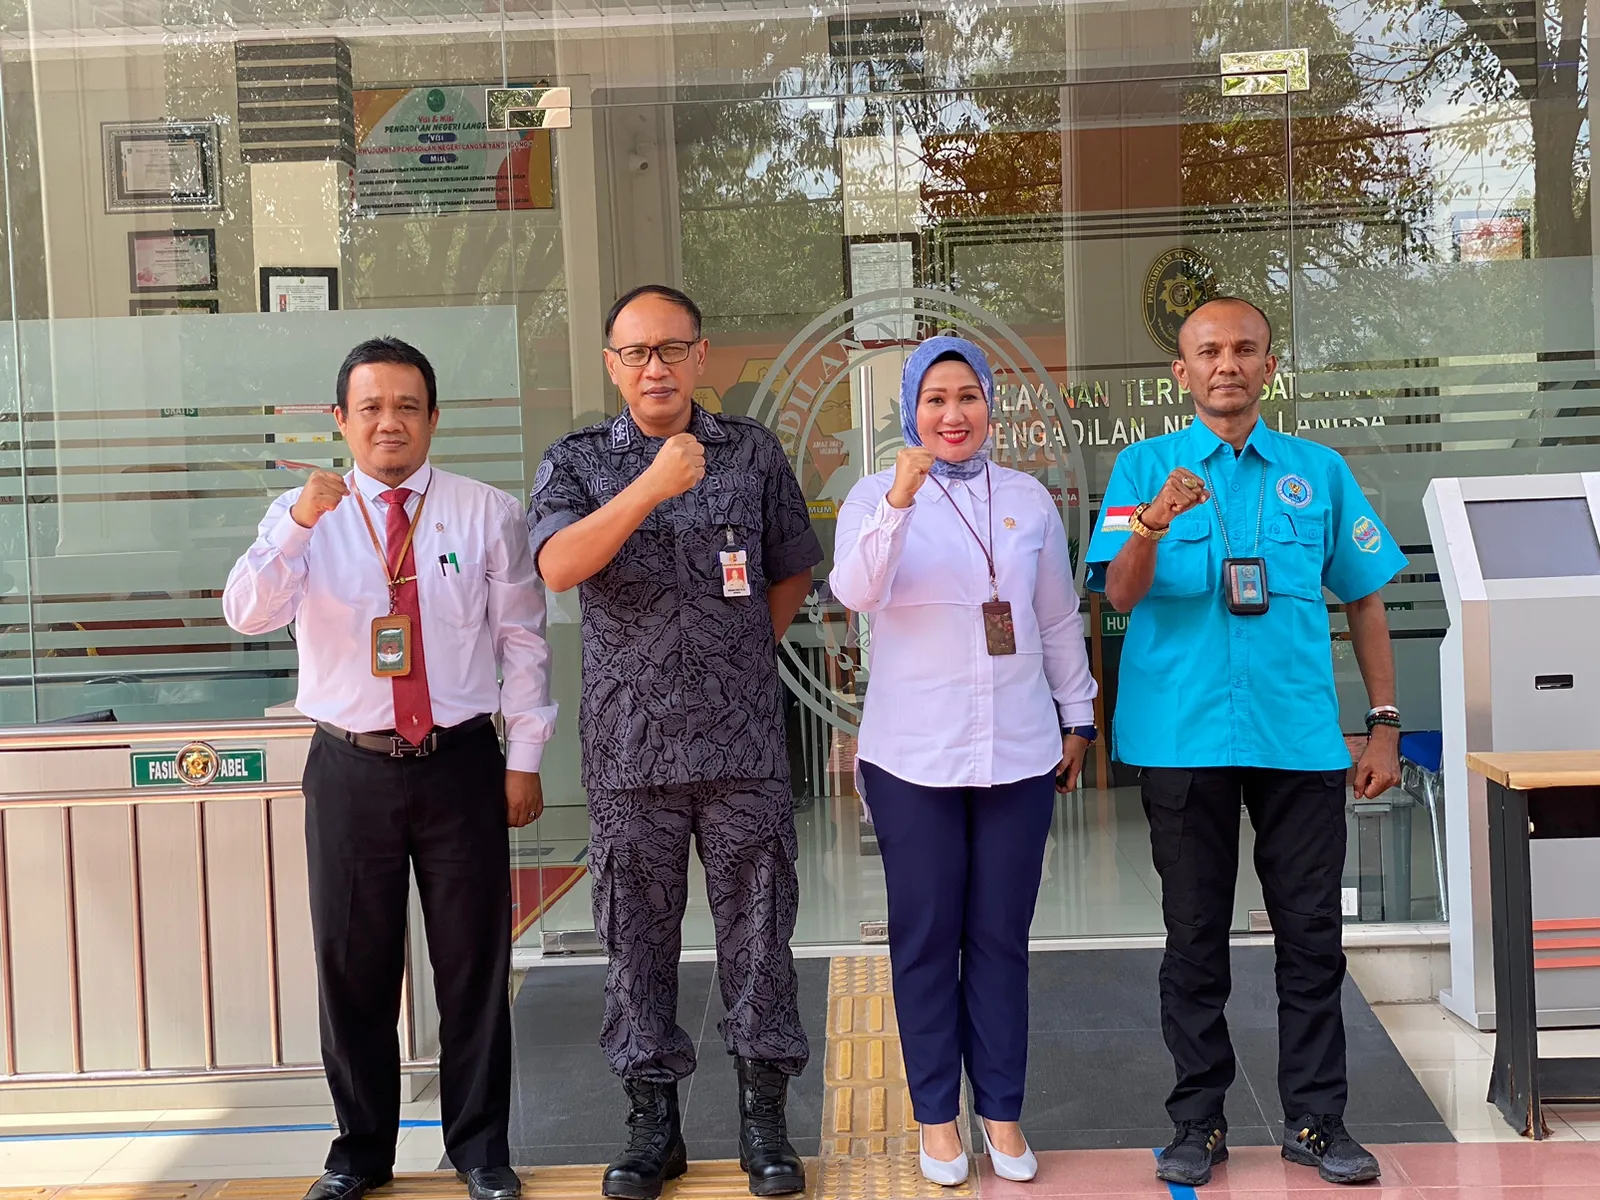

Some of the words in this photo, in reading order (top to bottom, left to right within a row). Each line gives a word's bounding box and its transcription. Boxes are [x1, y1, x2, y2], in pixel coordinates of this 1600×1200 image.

[384, 124, 431, 133] PENGADILAN
[432, 123, 460, 131] NEGERI
[462, 122, 487, 130] LANGS
[1147, 254, 1173, 304] PENGADILAN
[808, 505, 832, 514] MUM
